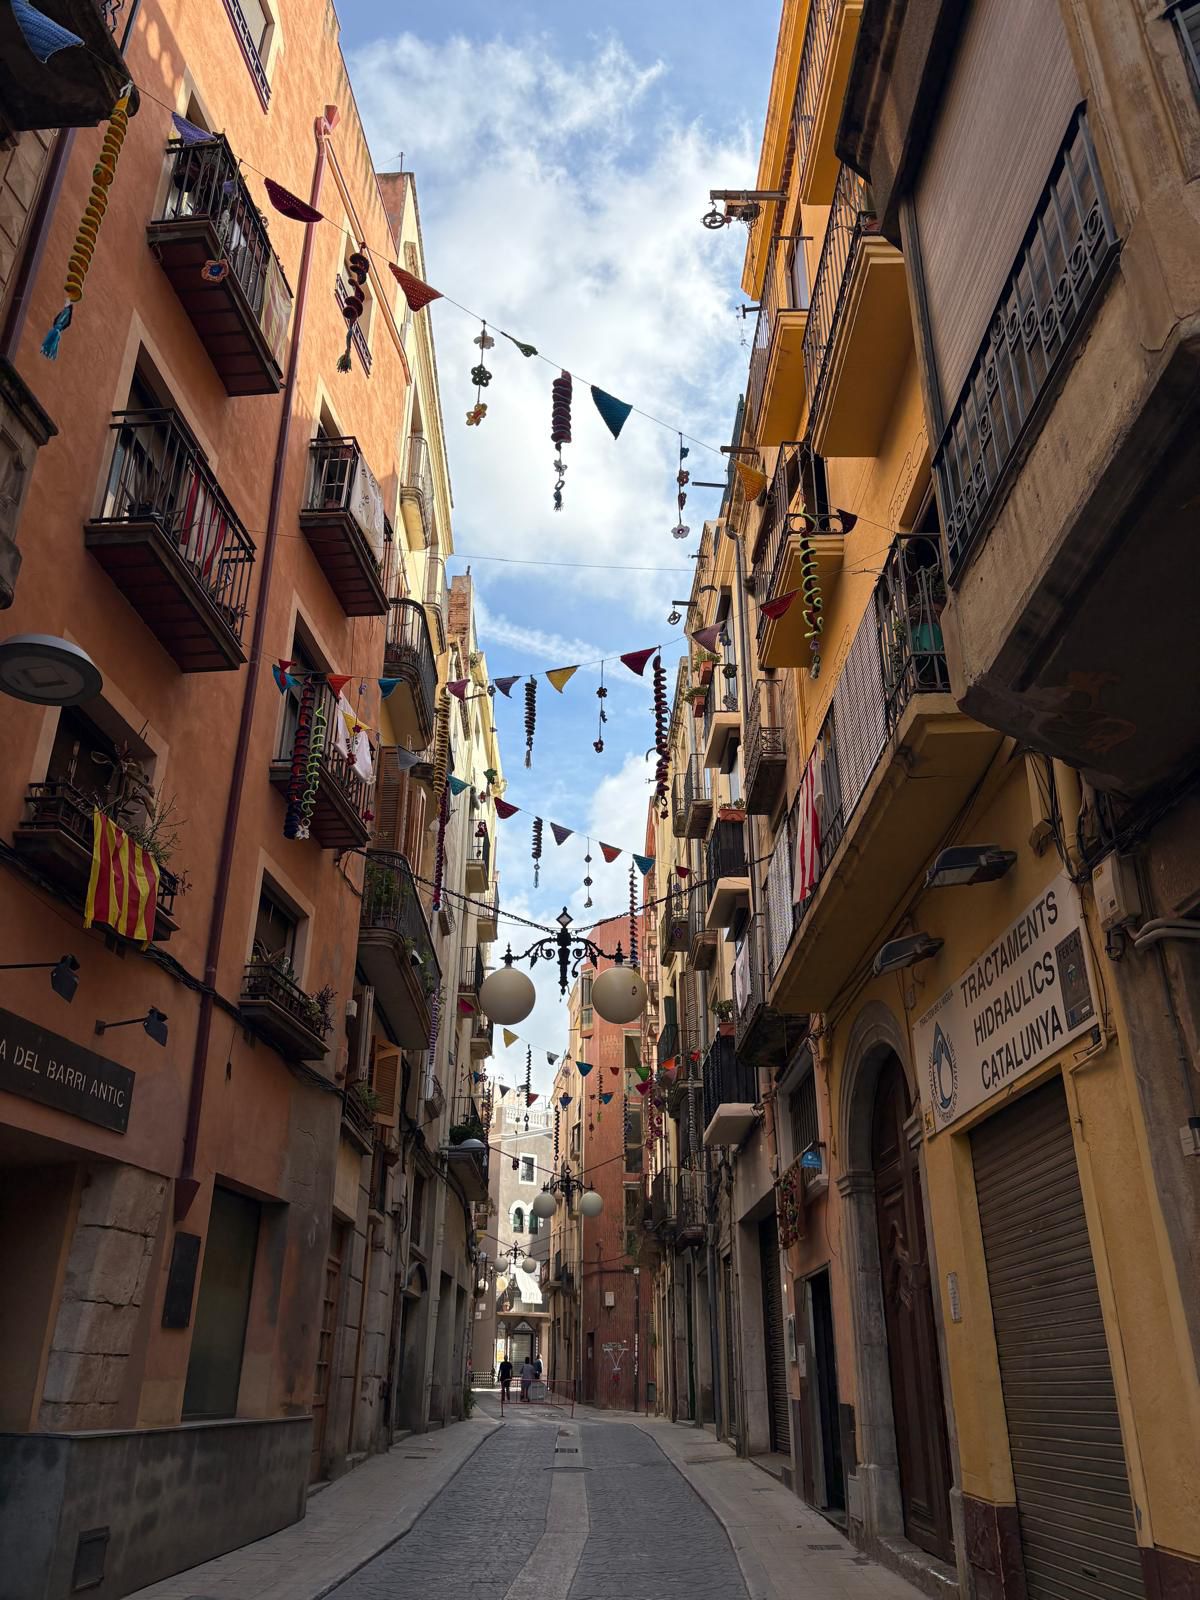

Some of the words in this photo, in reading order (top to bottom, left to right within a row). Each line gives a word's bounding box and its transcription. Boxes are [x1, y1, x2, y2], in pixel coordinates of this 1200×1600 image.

[973, 951, 1056, 1047] HIDRAULICS
[13, 1045, 40, 1074] DEL
[46, 1060, 87, 1092] BARRI
[89, 1079, 125, 1108] ANTIC
[981, 1005, 1063, 1090] CATALUNYA
